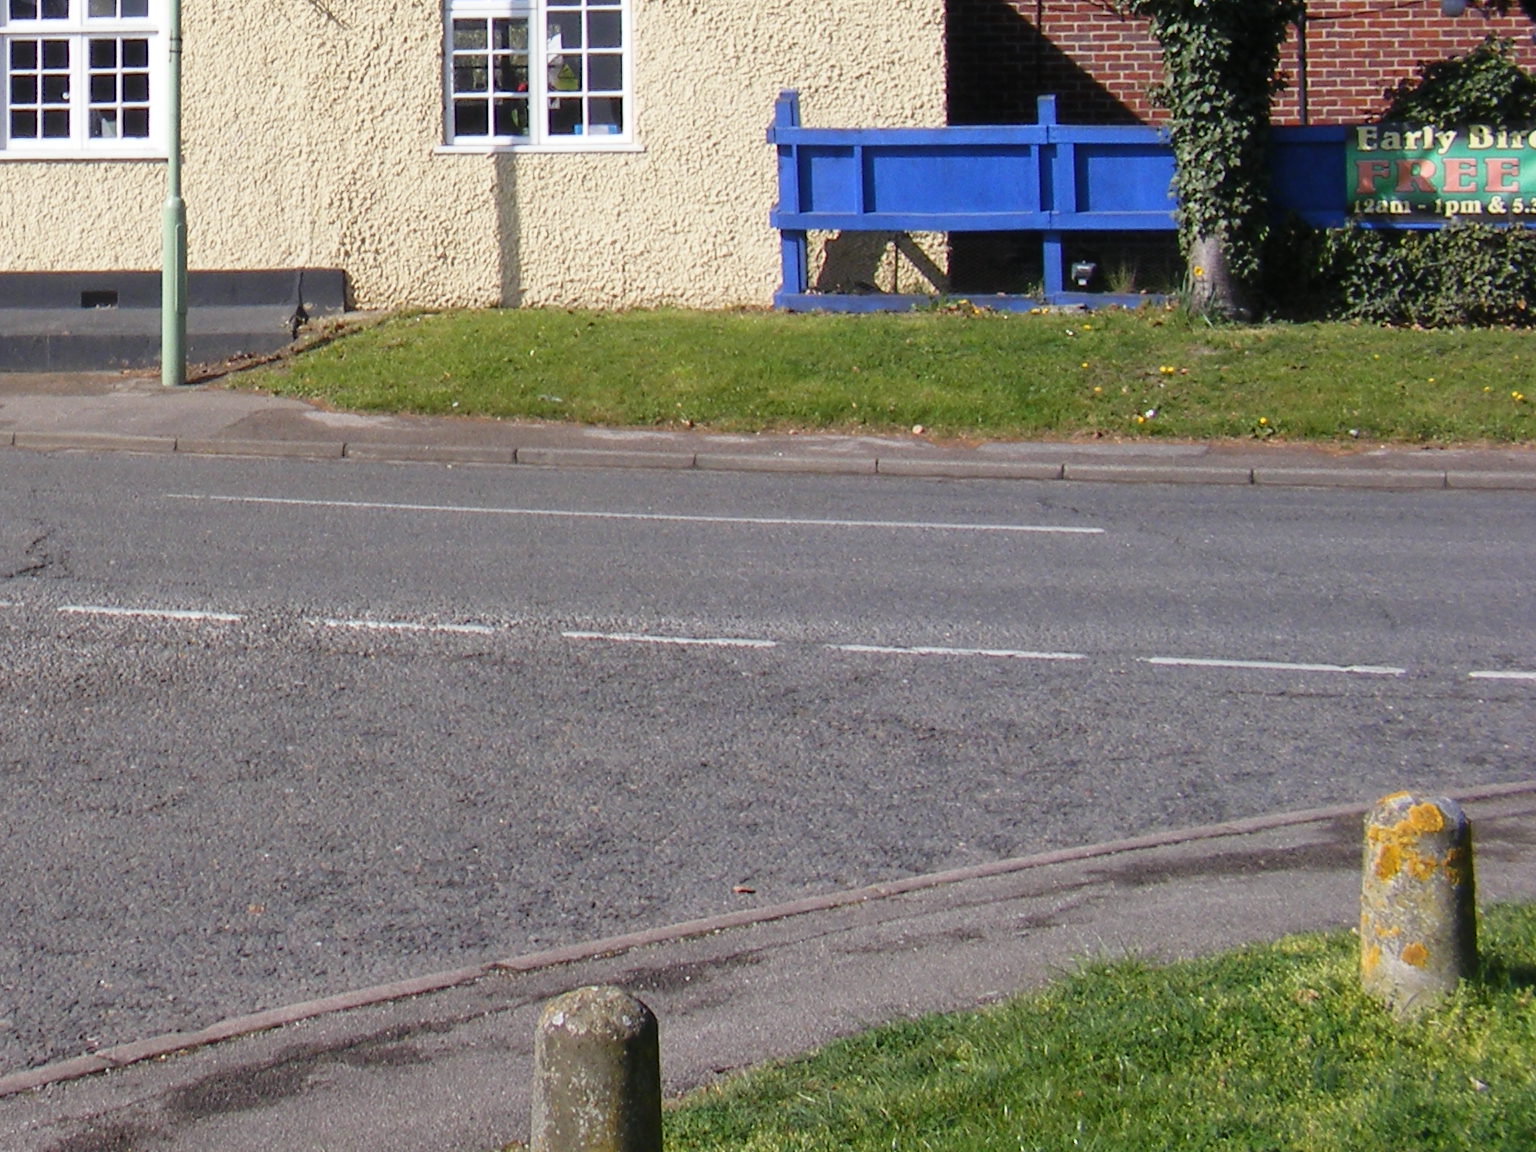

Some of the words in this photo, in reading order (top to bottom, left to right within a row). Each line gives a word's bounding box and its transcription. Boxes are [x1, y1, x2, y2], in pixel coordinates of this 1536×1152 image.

[1356, 125, 1457, 154] Early
[1356, 157, 1520, 193] FREE
[1354, 198, 1412, 214] 12am
[1434, 198, 1482, 218] 1pm
[1488, 196, 1506, 214] &
